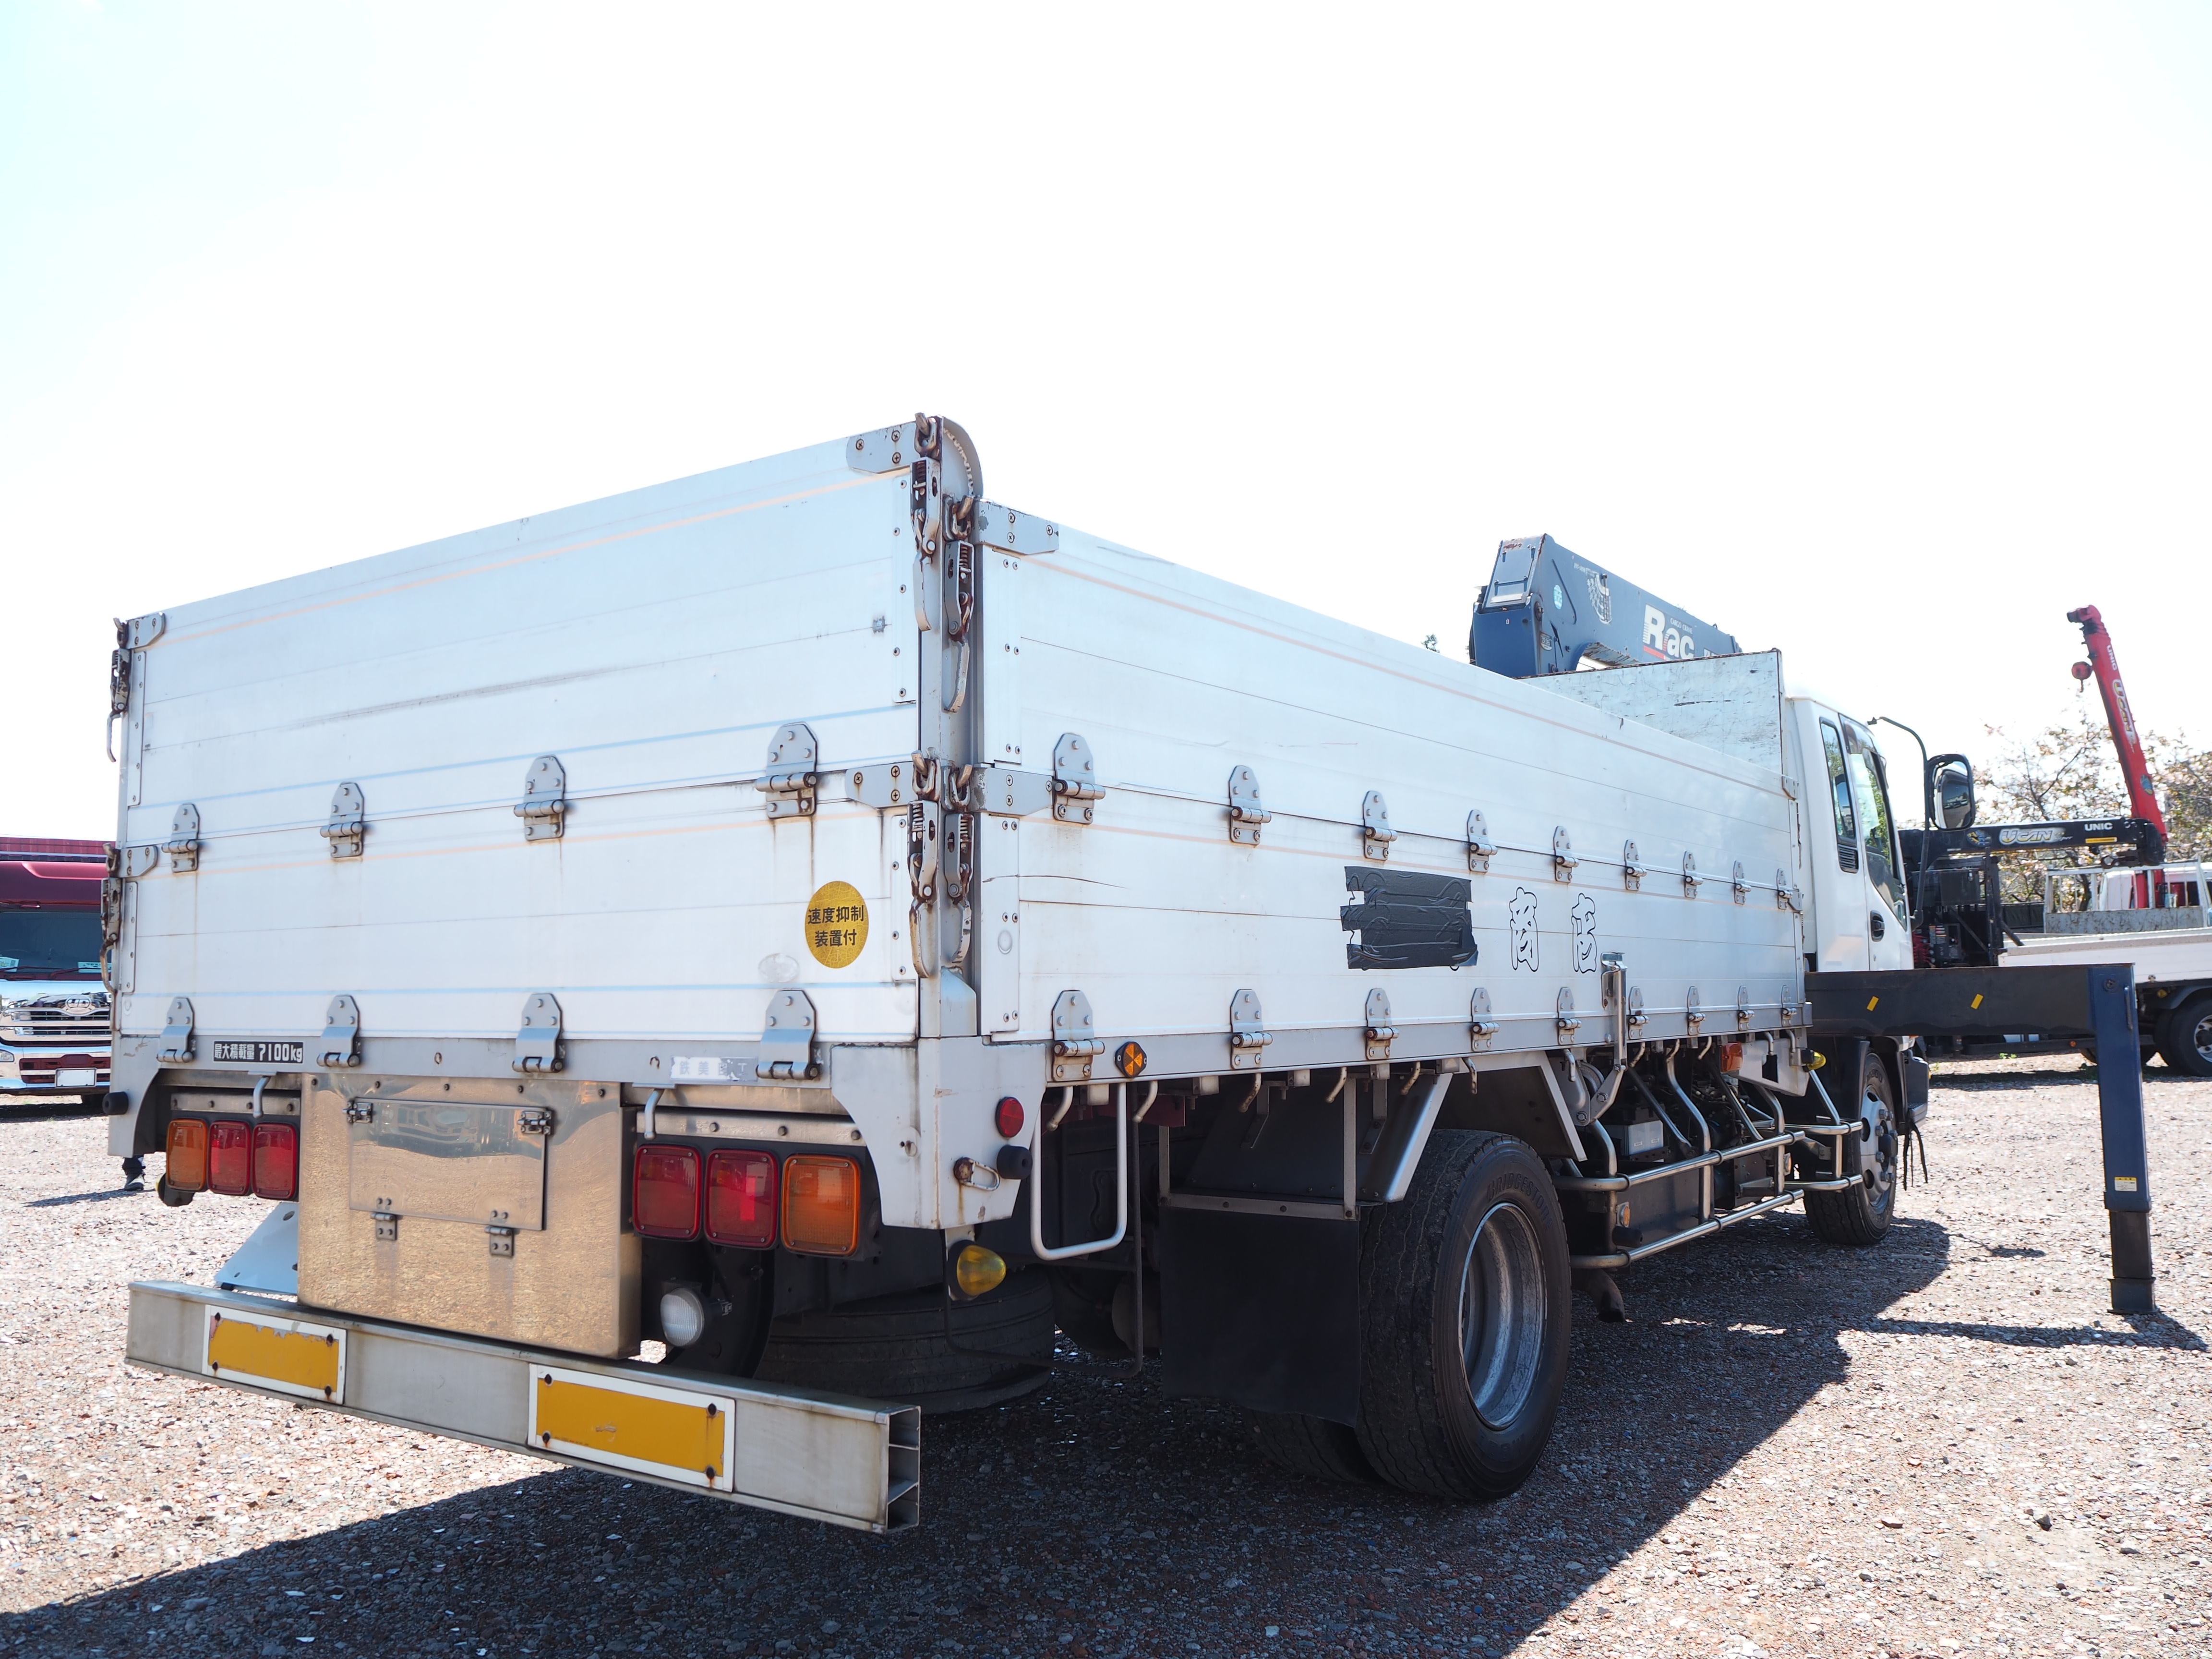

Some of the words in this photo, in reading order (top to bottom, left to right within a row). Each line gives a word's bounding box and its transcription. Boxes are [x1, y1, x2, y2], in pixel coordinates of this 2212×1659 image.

[1643, 604, 1695, 660] Rac
[2106, 645, 2117, 671] UNIC
[2084, 822, 2113, 831] UNIC
[807, 905, 865, 925] 速度抑制
[815, 928, 857, 948] 装置付
[214, 1043, 255, 1060] 最大積載量
[258, 1043, 303, 1062] 7100kg
[1486, 1172, 1553, 1232] BRIDGESTONE
